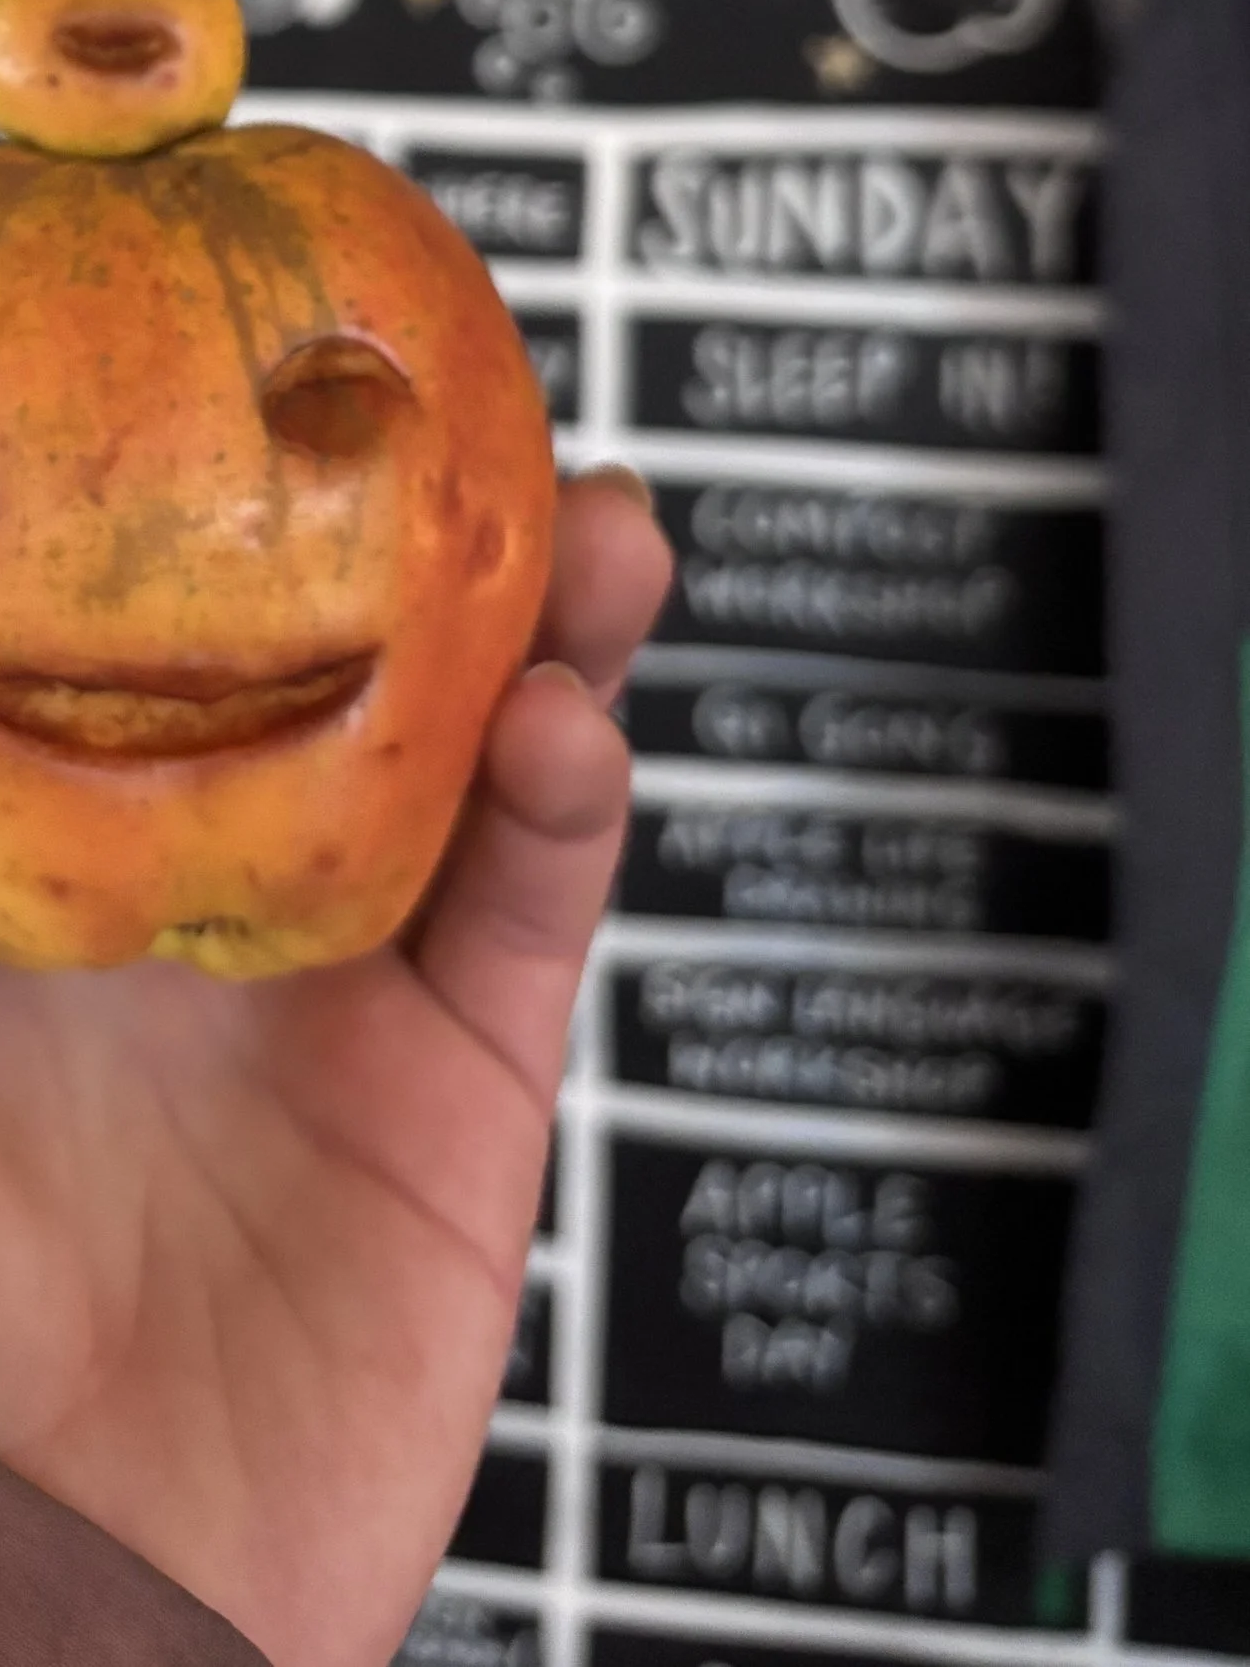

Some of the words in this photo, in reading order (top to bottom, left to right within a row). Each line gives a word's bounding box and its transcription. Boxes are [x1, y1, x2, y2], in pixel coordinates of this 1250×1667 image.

[640, 151, 1087, 280] SUNDAY
[681, 327, 912, 429] SLEEP
[626, 1464, 978, 1616] LUNCH
